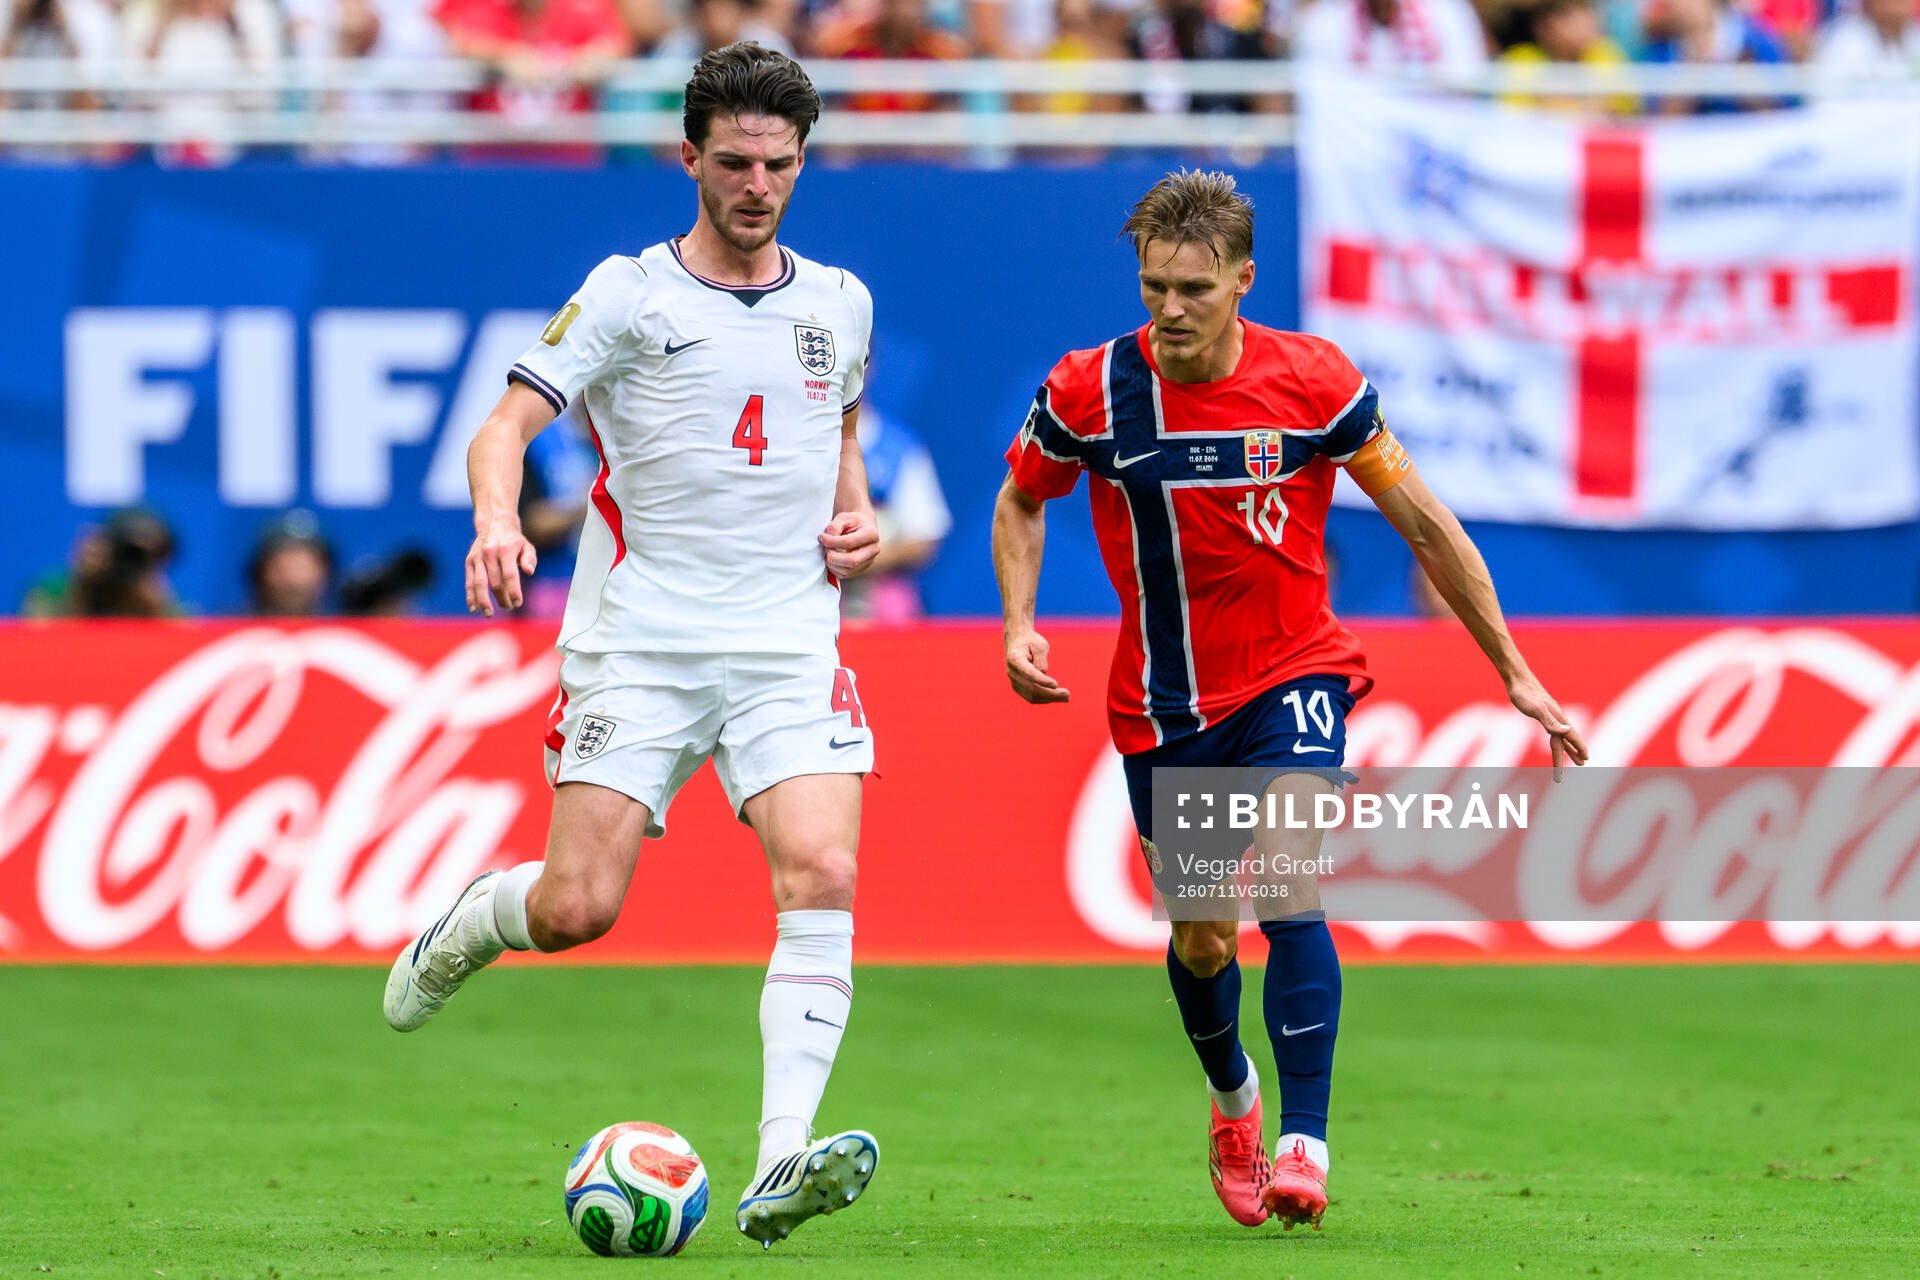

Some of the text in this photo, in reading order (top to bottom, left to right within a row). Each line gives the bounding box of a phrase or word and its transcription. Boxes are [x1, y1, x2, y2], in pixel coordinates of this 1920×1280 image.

[804, 380, 829, 390] NORWAY
[807, 391, 827, 401] 11.07.26
[732, 394, 768, 466] 4
[1237, 487, 1289, 546] 10
[831, 668, 863, 728] 4
[1282, 689, 1335, 740] 10
